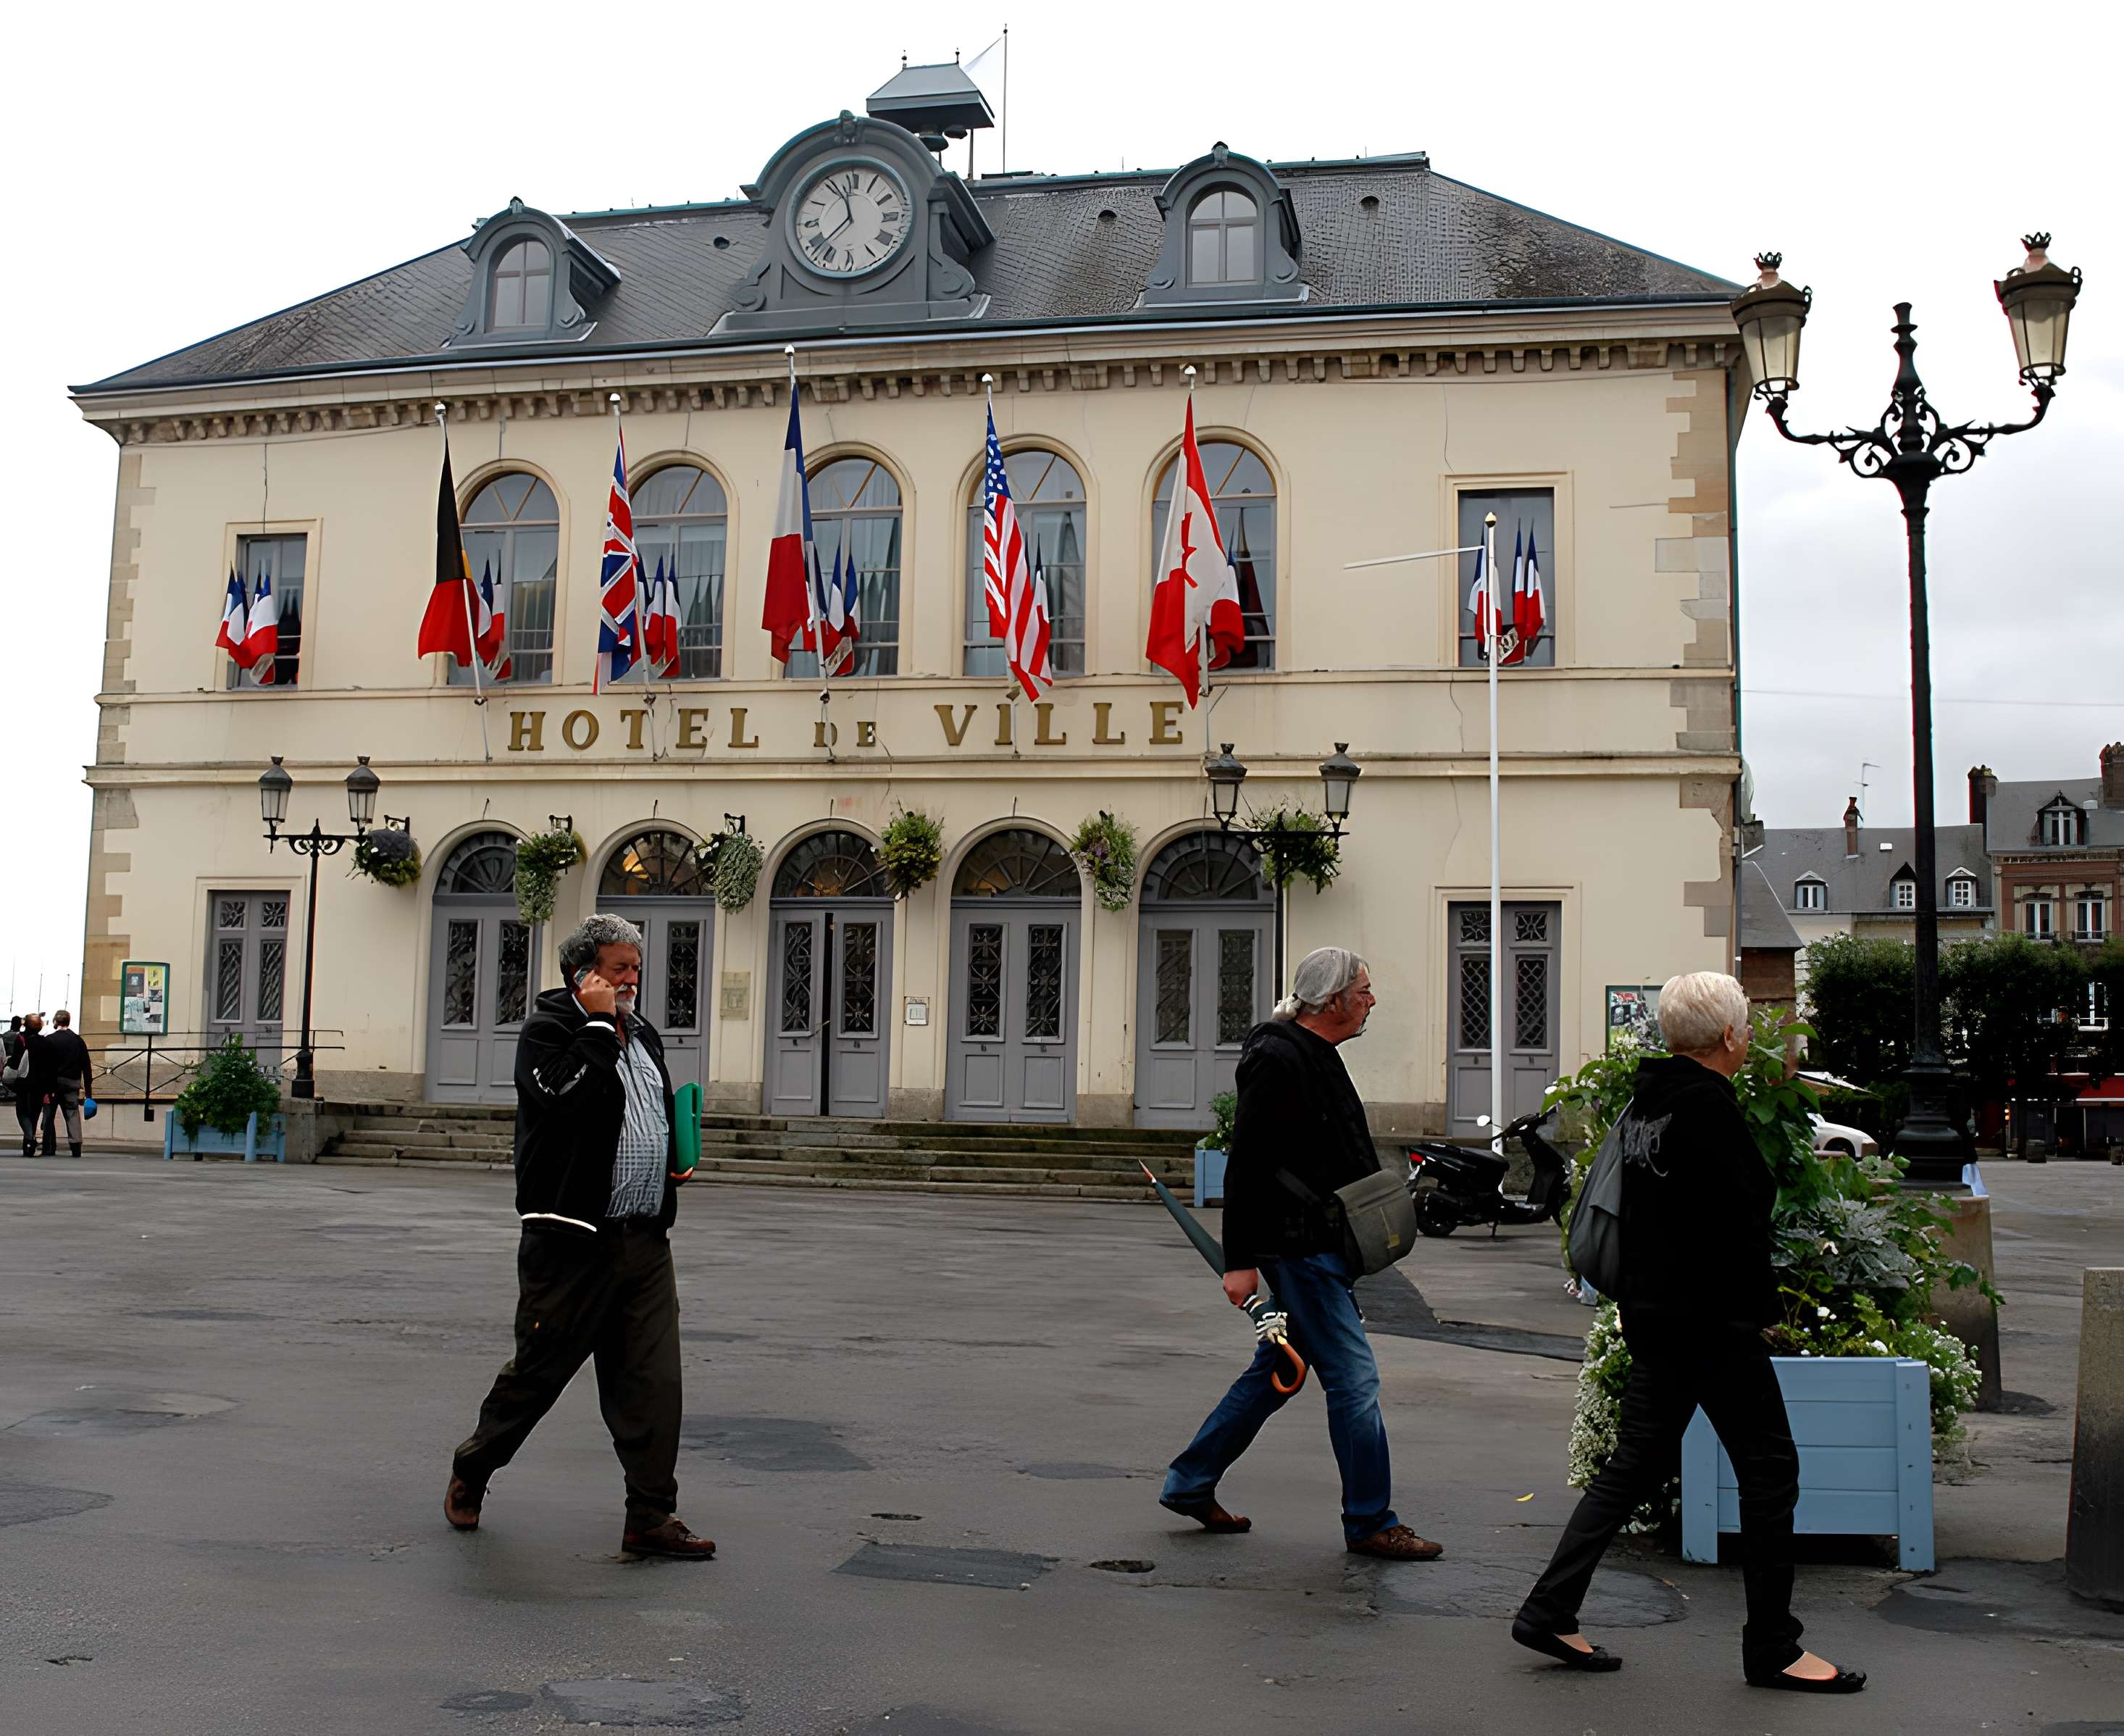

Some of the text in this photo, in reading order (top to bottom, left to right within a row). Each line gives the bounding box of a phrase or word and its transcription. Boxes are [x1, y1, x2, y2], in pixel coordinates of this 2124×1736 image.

[508, 701, 1184, 751] HOTEL DE VILLE
